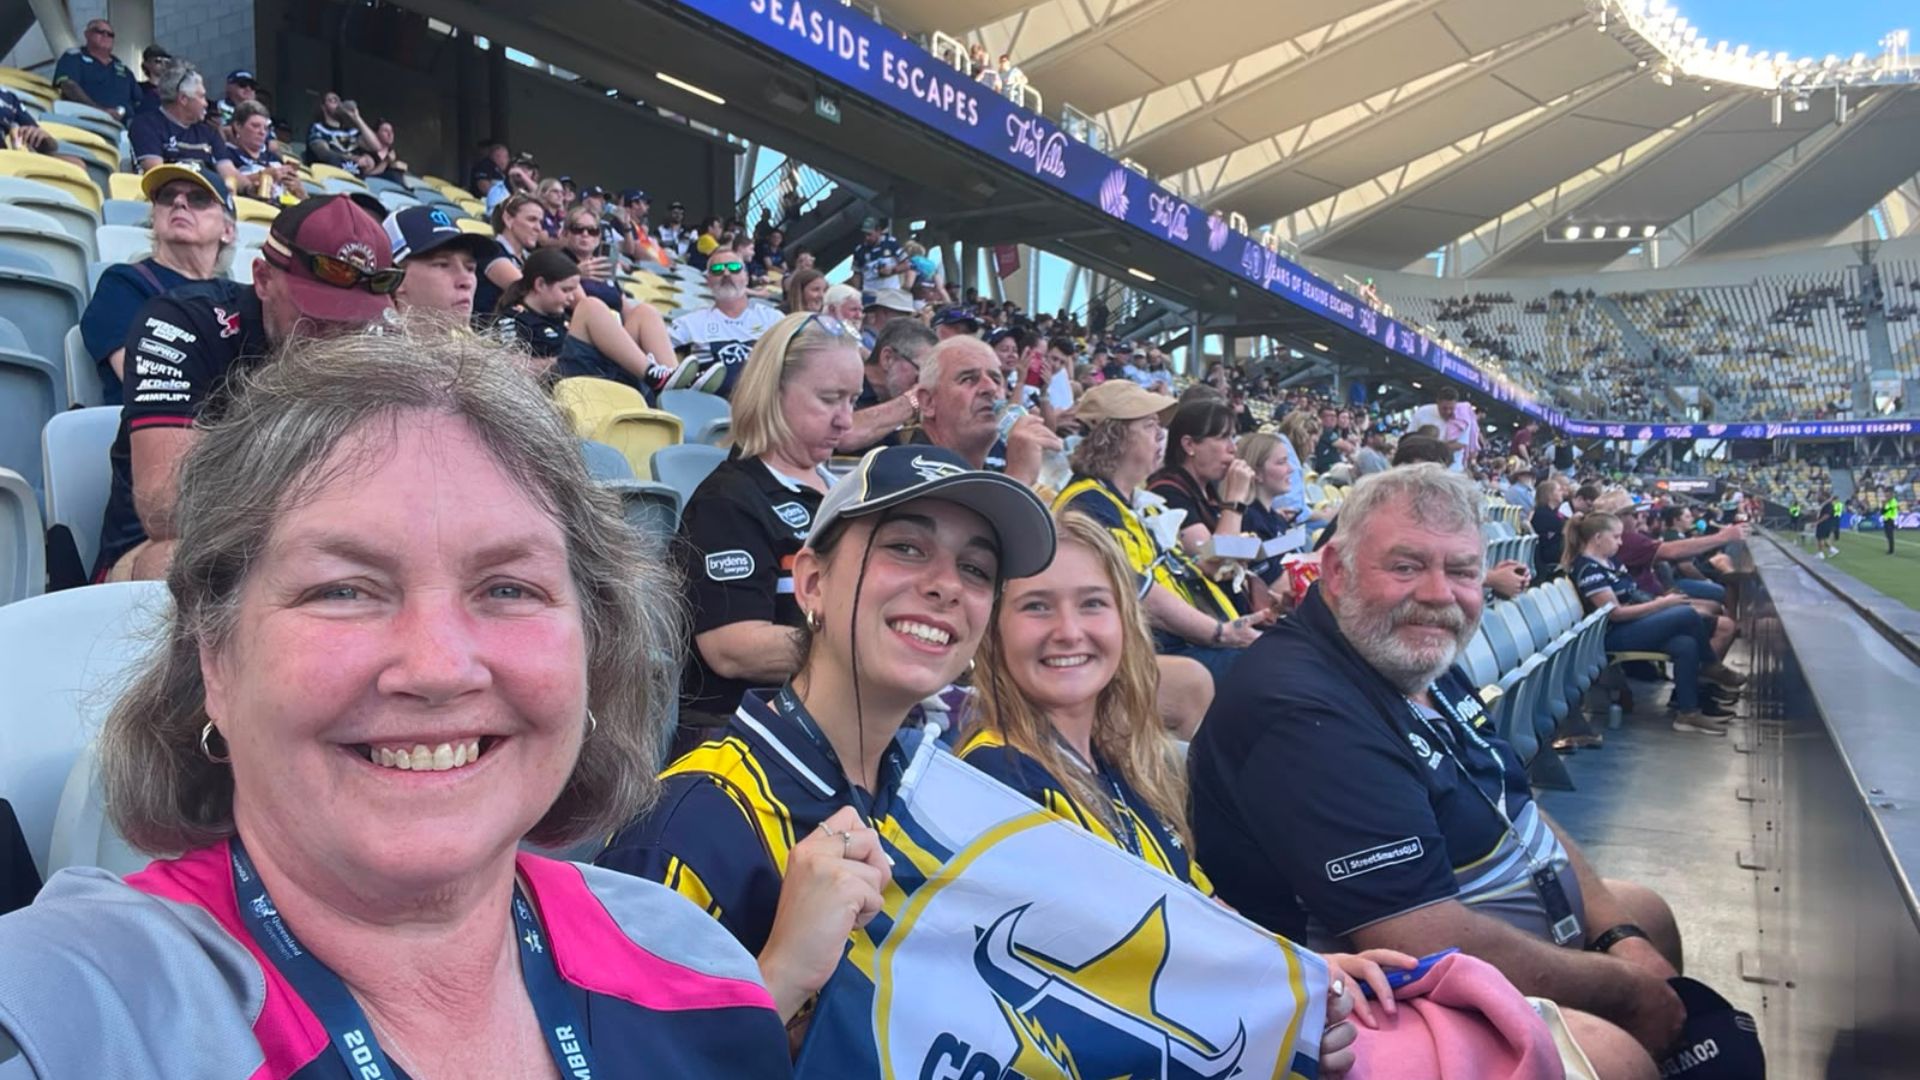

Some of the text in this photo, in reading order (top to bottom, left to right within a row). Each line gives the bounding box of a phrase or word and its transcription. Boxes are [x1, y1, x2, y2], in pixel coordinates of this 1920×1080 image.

[882, 50, 979, 126] ESCAPES
[1006, 113, 1069, 179] The Ville
[136, 379, 191, 391] ACDelco
[1804, 426, 1817, 435] OF
[1821, 424, 1862, 434] SEASIDE
[1866, 422, 1913, 433] ESCAPES
[709, 556, 749, 570] brydens
[271, 914, 302, 958] Queensland
[343, 1028, 387, 1080] 202
